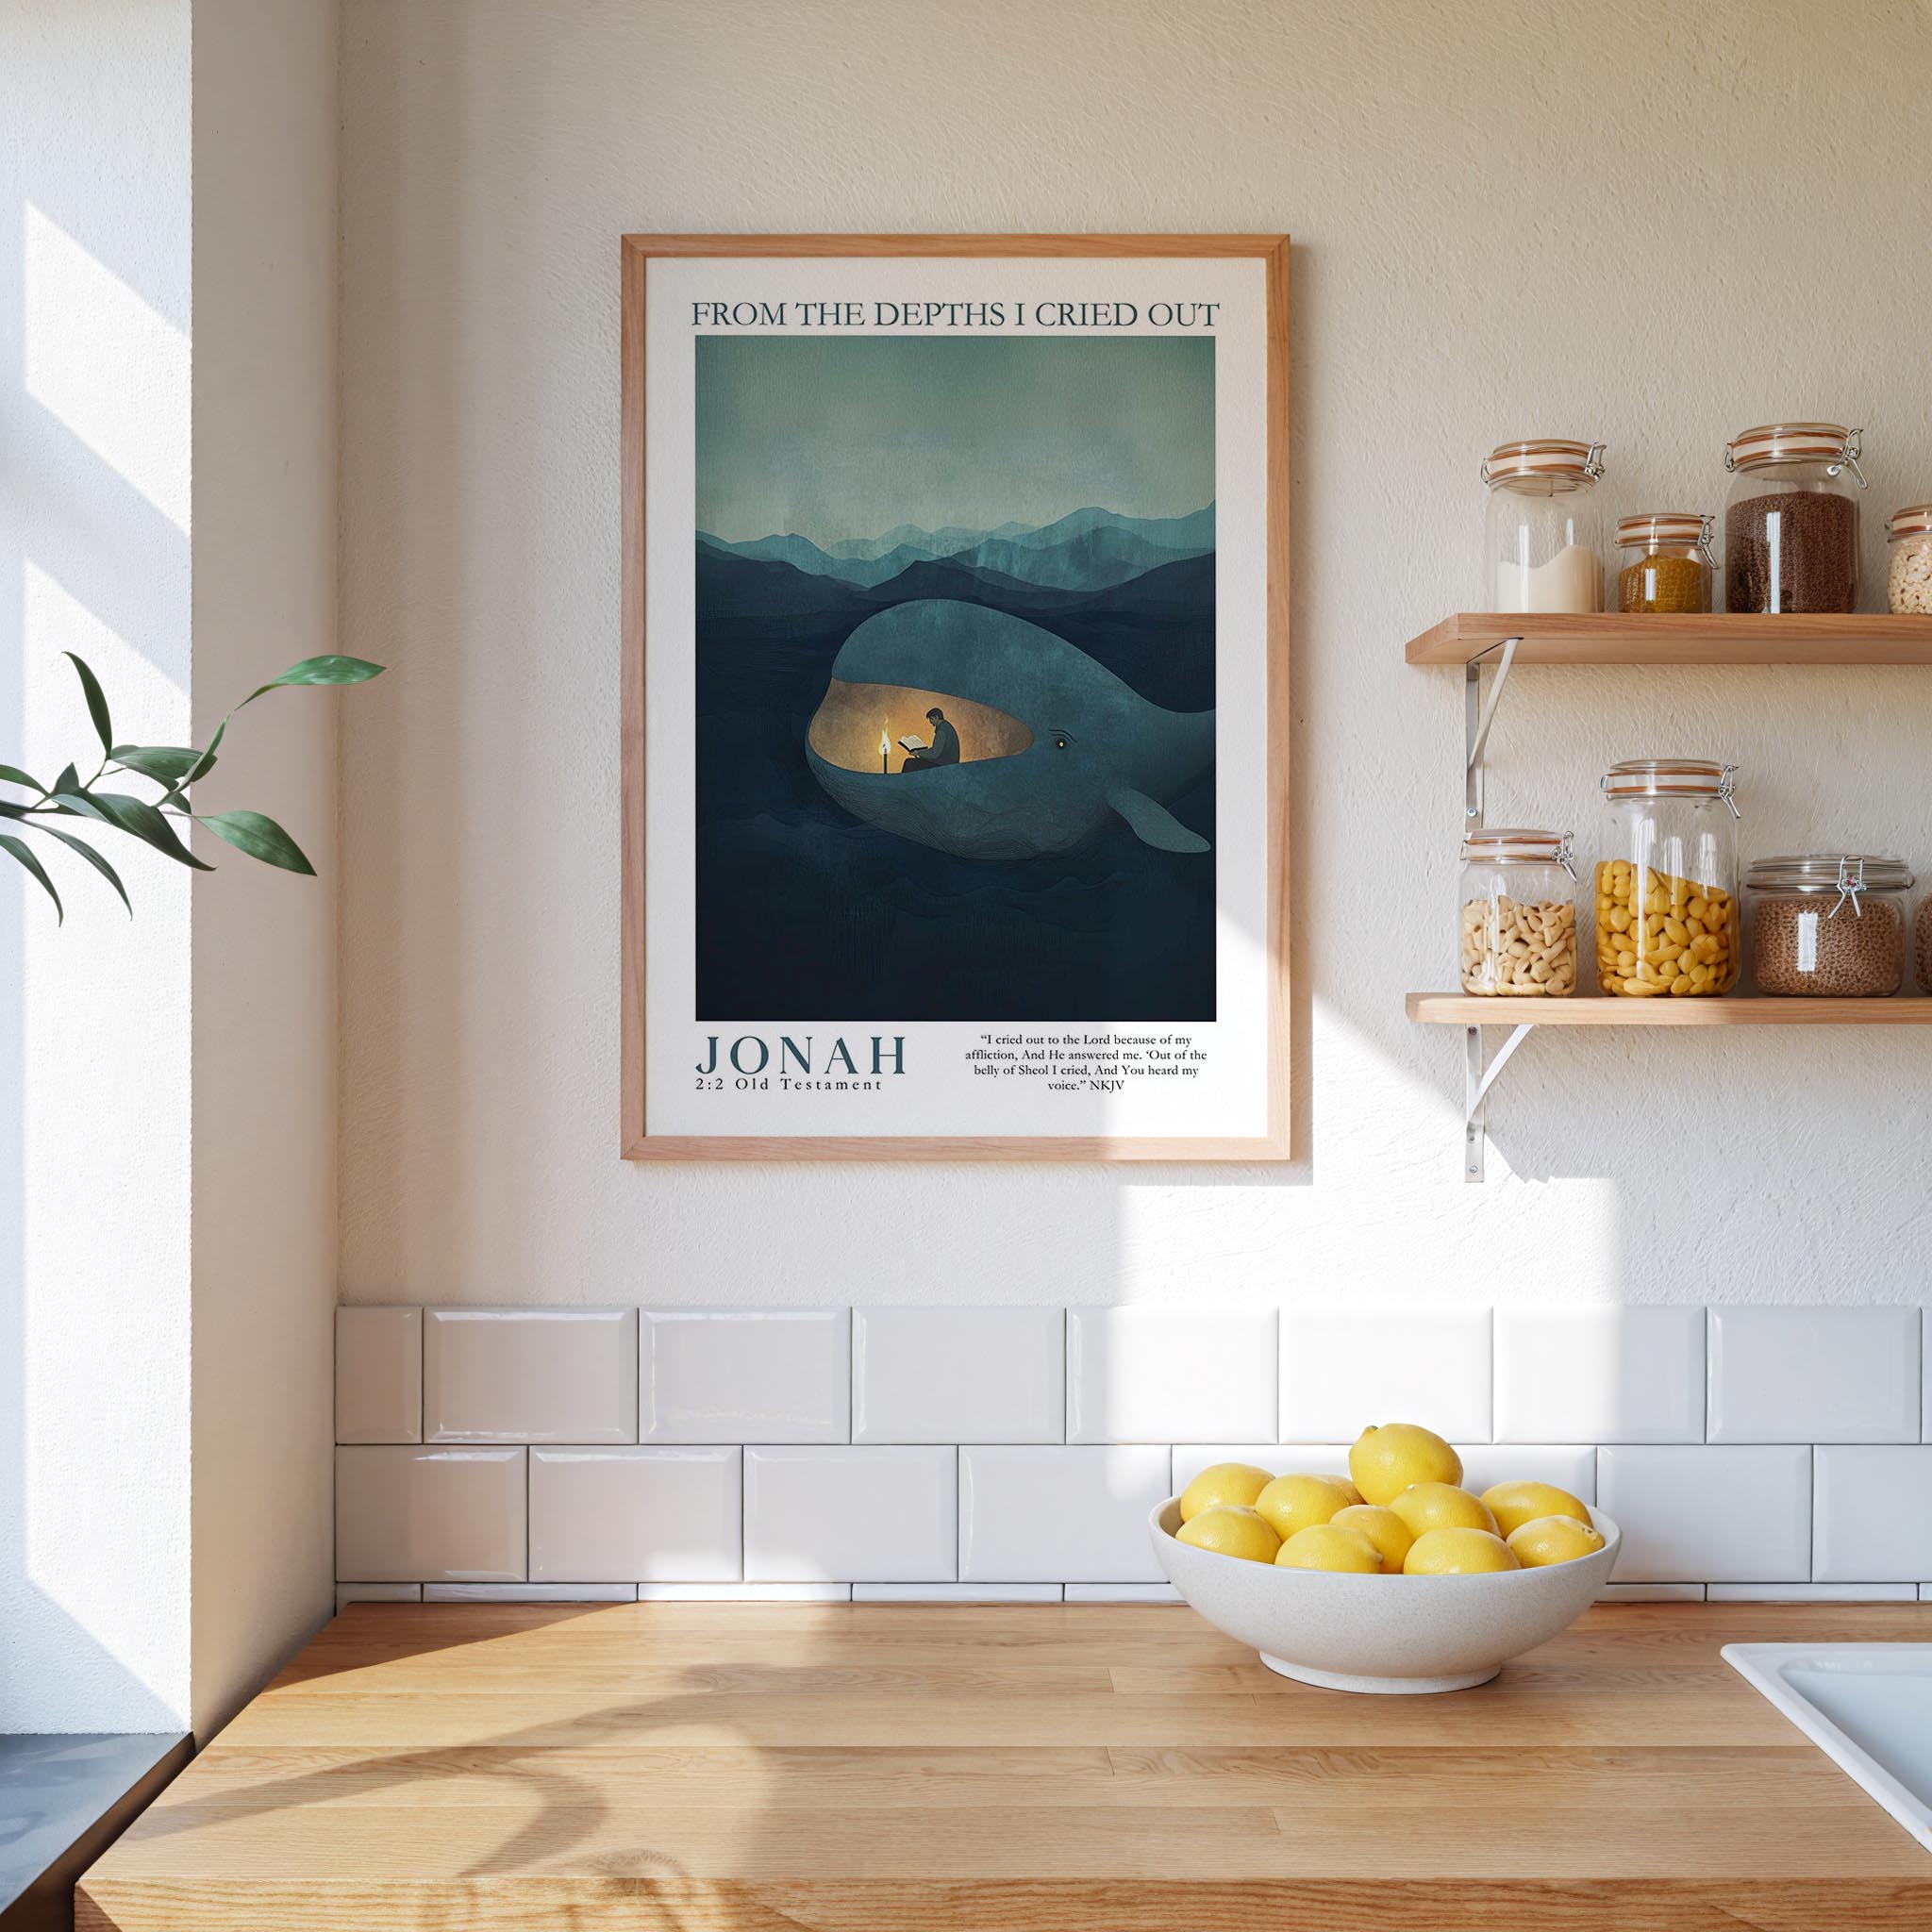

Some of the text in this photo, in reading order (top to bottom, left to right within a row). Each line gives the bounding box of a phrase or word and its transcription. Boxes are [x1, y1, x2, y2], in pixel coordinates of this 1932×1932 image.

[691, 301, 1221, 327] FROM THE DEPTHS I CRIED OUT
[994, 1033, 1024, 1045] cried
[1025, 1037, 1045, 1045] out
[1047, 1036, 1060, 1045] to
[1062, 1034, 1081, 1045] the
[1083, 1034, 1110, 1045] Lord
[1113, 1033, 1158, 1045] because
[1158, 1033, 1174, 1045] of
[1174, 1037, 1192, 1048] my
[694, 1035, 907, 1075] JONAH
[965, 1049, 1019, 1062] affliction,
[1021, 1049, 1046, 1060] And
[1048, 1049, 1066, 1060] He
[1067, 1049, 1120, 1061] answered
[1122, 1052, 1143, 1060] me.
[1174, 1049, 1189, 1060] of
[1189, 1049, 1208, 1060] the
[974, 1064, 1199, 1079] belly of Sheol I cried, And You heard my
[695, 1077, 882, 1091] 2:2 Old Testament
[1089, 1079, 1125, 1094] NKJV
